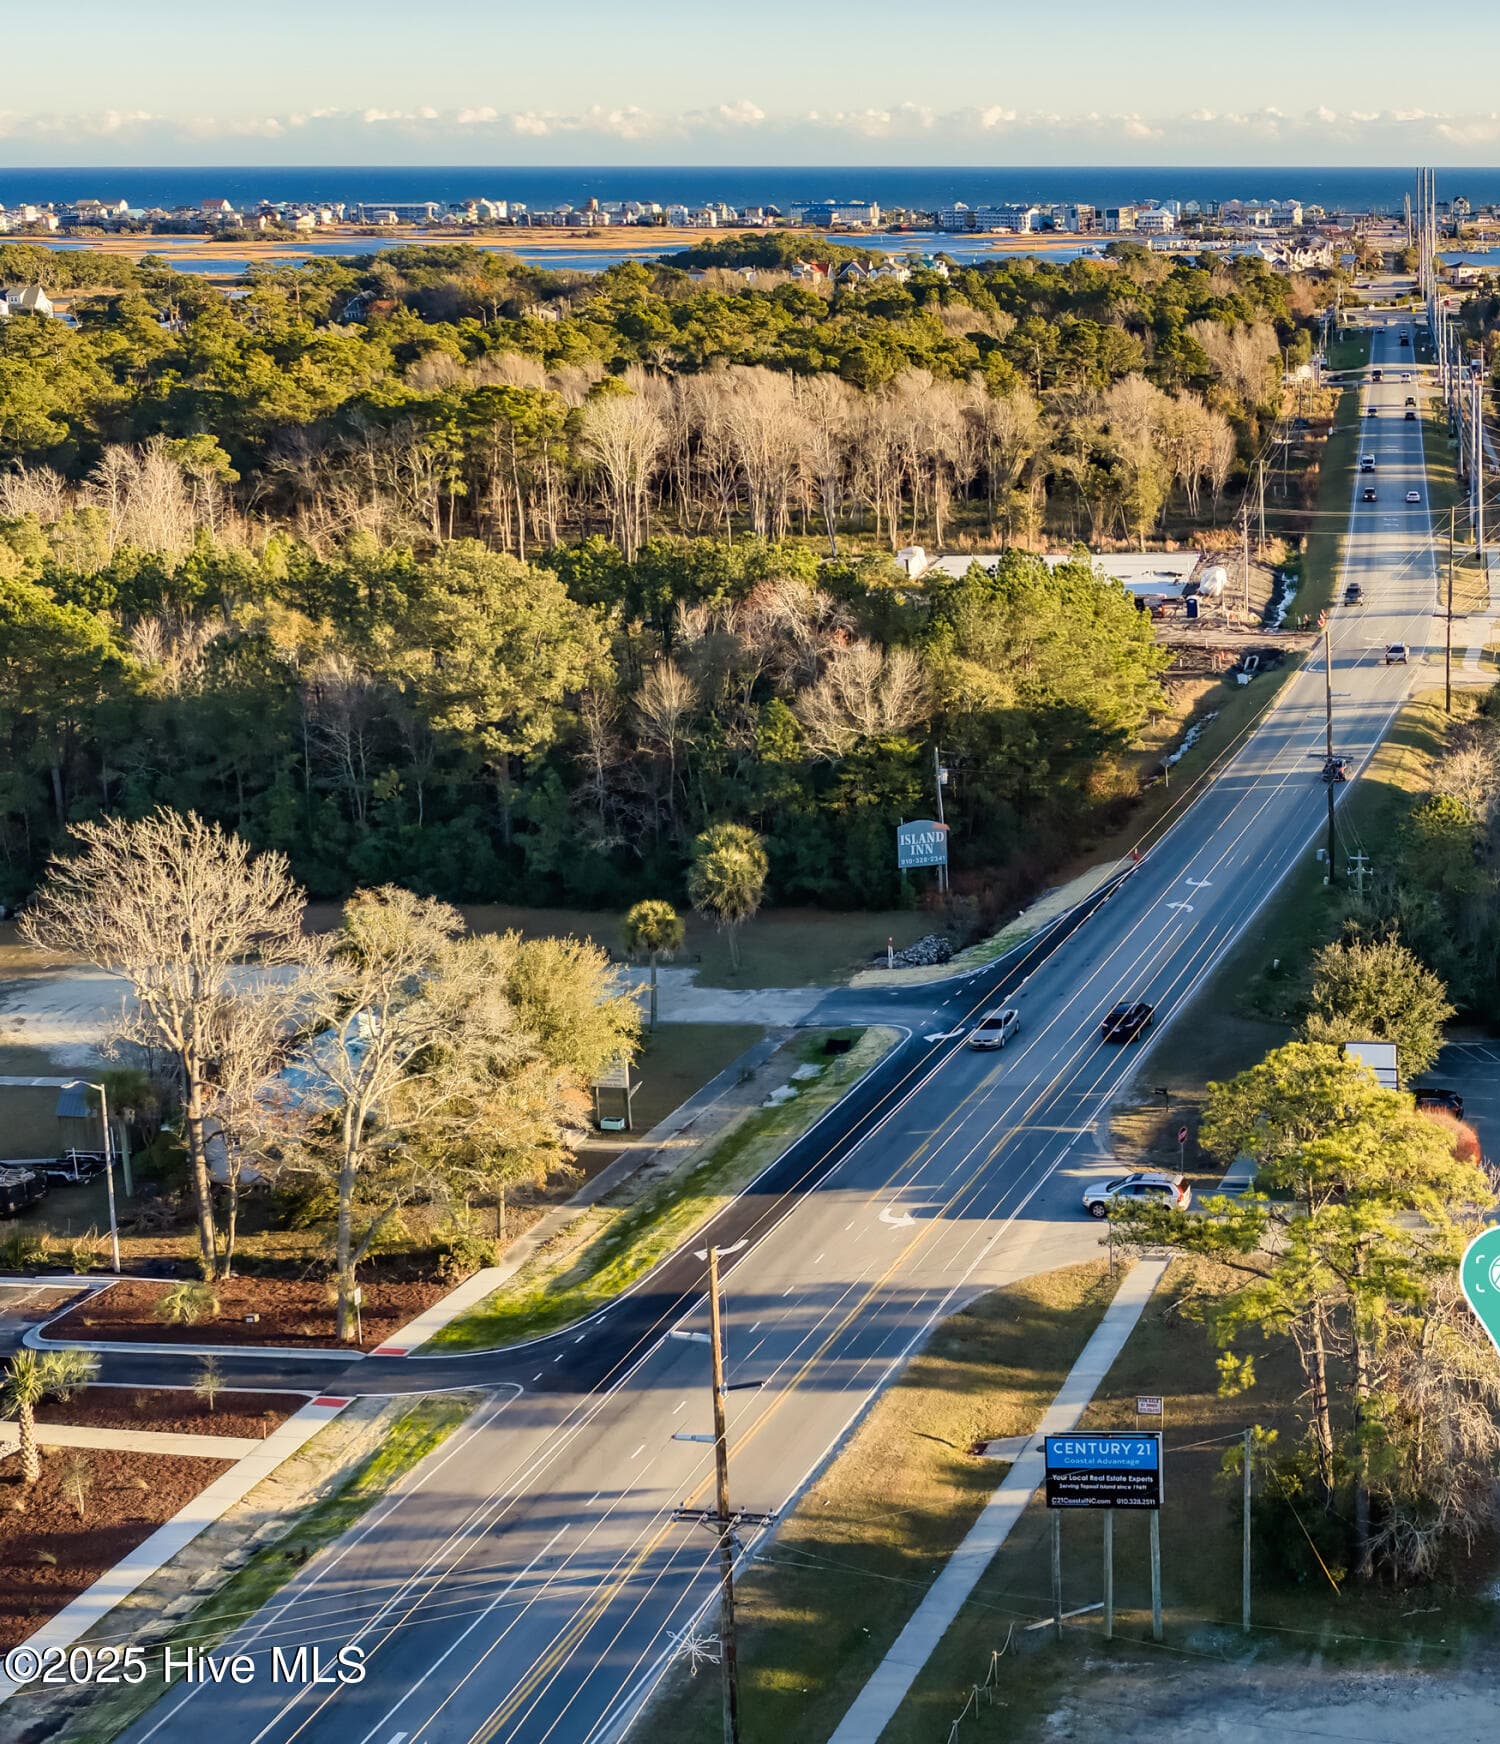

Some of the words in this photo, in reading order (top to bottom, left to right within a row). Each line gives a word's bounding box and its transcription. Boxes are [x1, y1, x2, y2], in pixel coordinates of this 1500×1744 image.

[900, 831, 945, 846] ISLAND
[910, 843, 934, 856] INN
[1053, 1442, 1132, 1455] CENTURY
[1136, 1443, 1151, 1456] 21
[1064, 1457, 1095, 1465] Coastal
[1096, 1458, 1140, 1467] Advantage
[1052, 1474, 1068, 1482] Your
[1068, 1474, 1089, 1482] Local
[1089, 1474, 1105, 1482] Real
[1128, 1475, 1154, 1483] Experts
